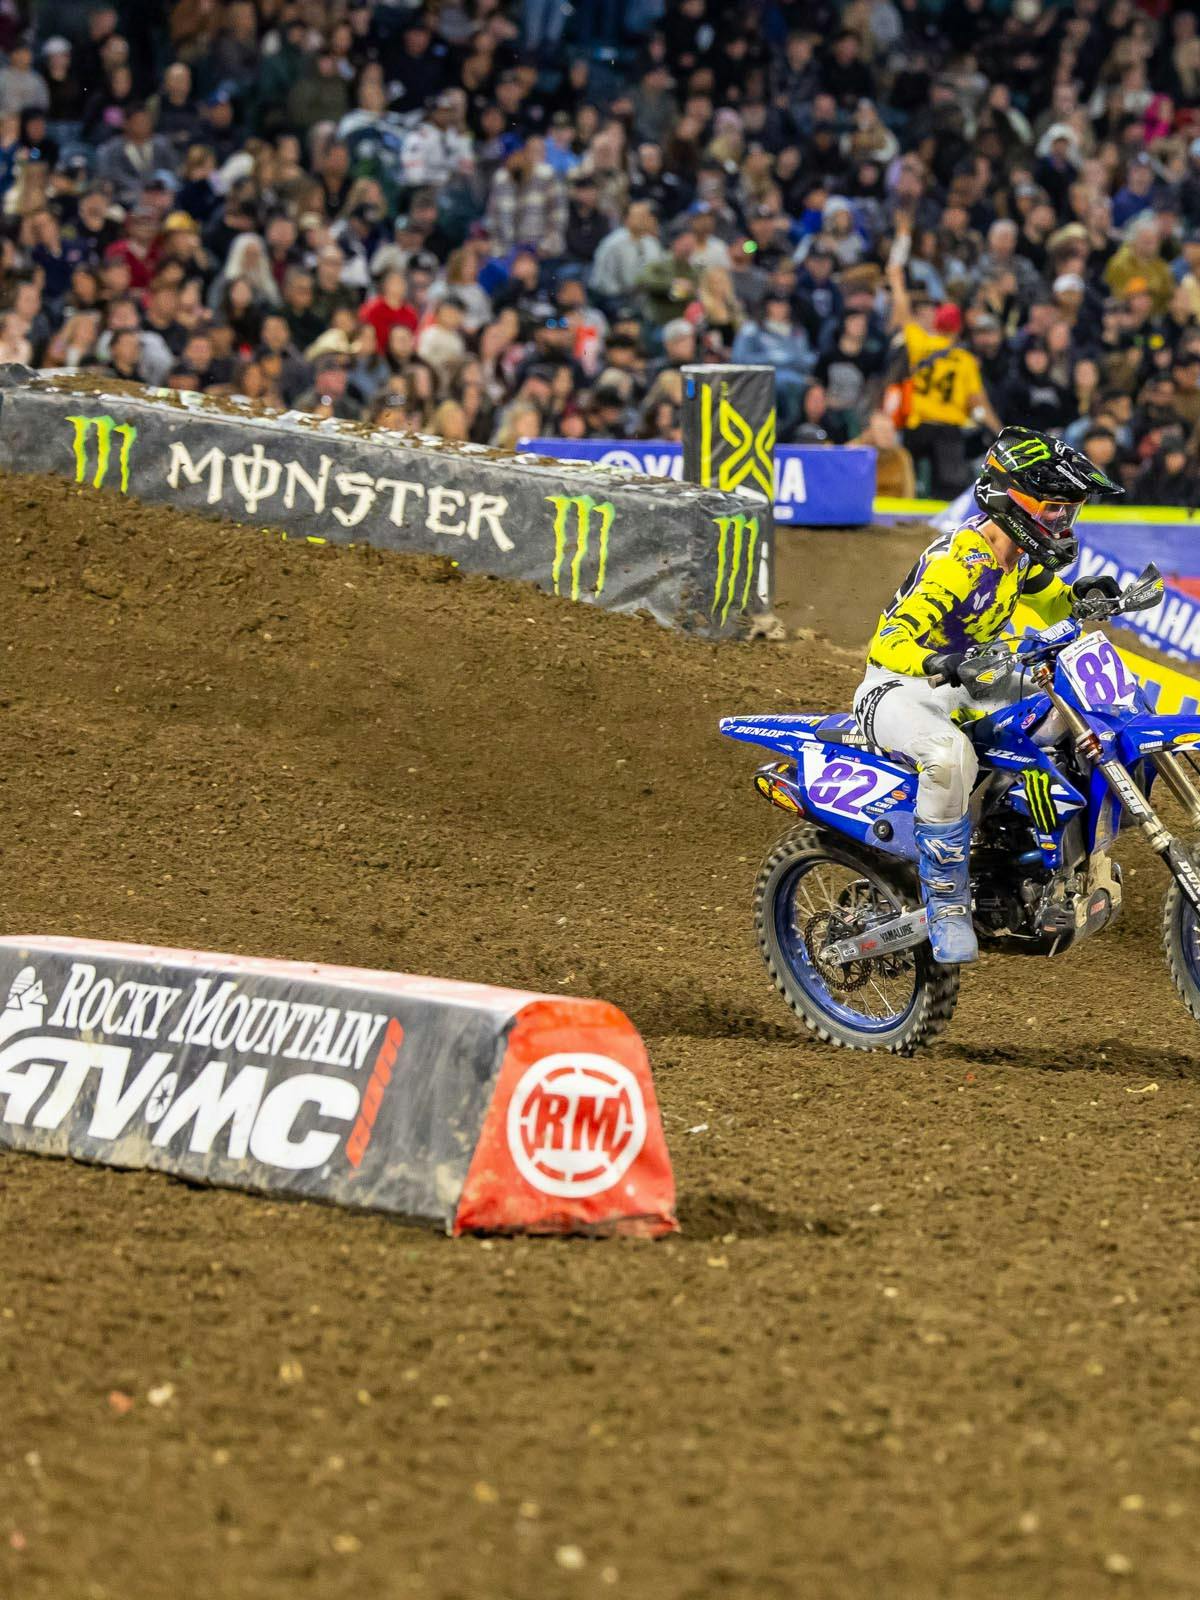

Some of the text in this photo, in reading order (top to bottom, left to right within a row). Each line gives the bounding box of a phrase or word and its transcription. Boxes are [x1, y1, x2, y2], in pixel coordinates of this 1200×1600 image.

[167, 441, 516, 553] MONSTER
[1076, 642, 1136, 705] 82
[733, 725, 787, 739] DUNLOP
[808, 762, 878, 815] 82
[48, 963, 389, 1071] ROCKY MOUNTAIN
[533, 1093, 632, 1151] RM
